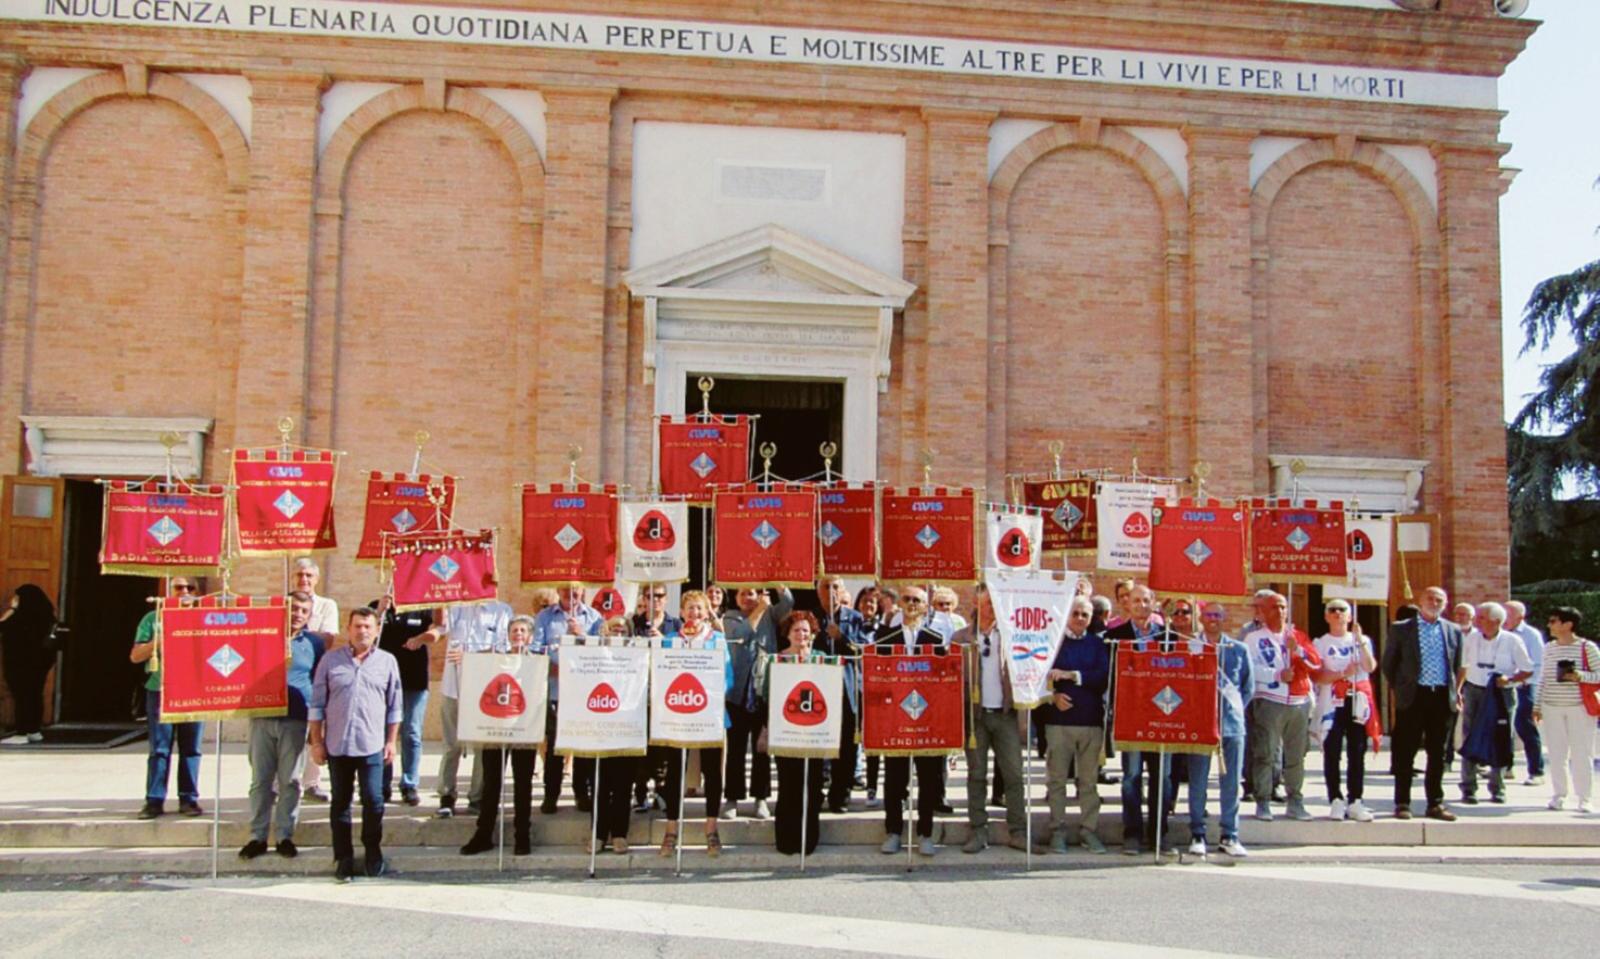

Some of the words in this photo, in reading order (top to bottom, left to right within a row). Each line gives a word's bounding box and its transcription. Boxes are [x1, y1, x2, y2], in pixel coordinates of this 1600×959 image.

[45, 0, 230, 24] INDULGENZA
[249, 6, 396, 33] PLENARIA
[412, 14, 588, 44] QUOTIDIANA
[605, 25, 753, 54] PERPETUA
[770, 36, 787, 56] E
[802, 37, 944, 66] MOLTISSIME
[961, 50, 1045, 73] ALTRE
[1056, 55, 1105, 77] PER
[1121, 60, 1144, 79] LI
[1158, 62, 1207, 84] VIVI
[1217, 67, 1231, 86] E
[1241, 68, 1283, 89] PER
[1297, 73, 1316, 91] LI
[1332, 74, 1404, 98] MORTI
[820, 493, 845, 504] VIS
[1042, 482, 1089, 500] AVIS
[912, 501, 944, 512] AVIS
[1015, 606, 1048, 631] FIDAS
[588, 694, 619, 709] aido
[668, 689, 705, 707] aido
[883, 738, 945, 746] LENDINARA
[1136, 730, 1198, 740] ROVIGO
